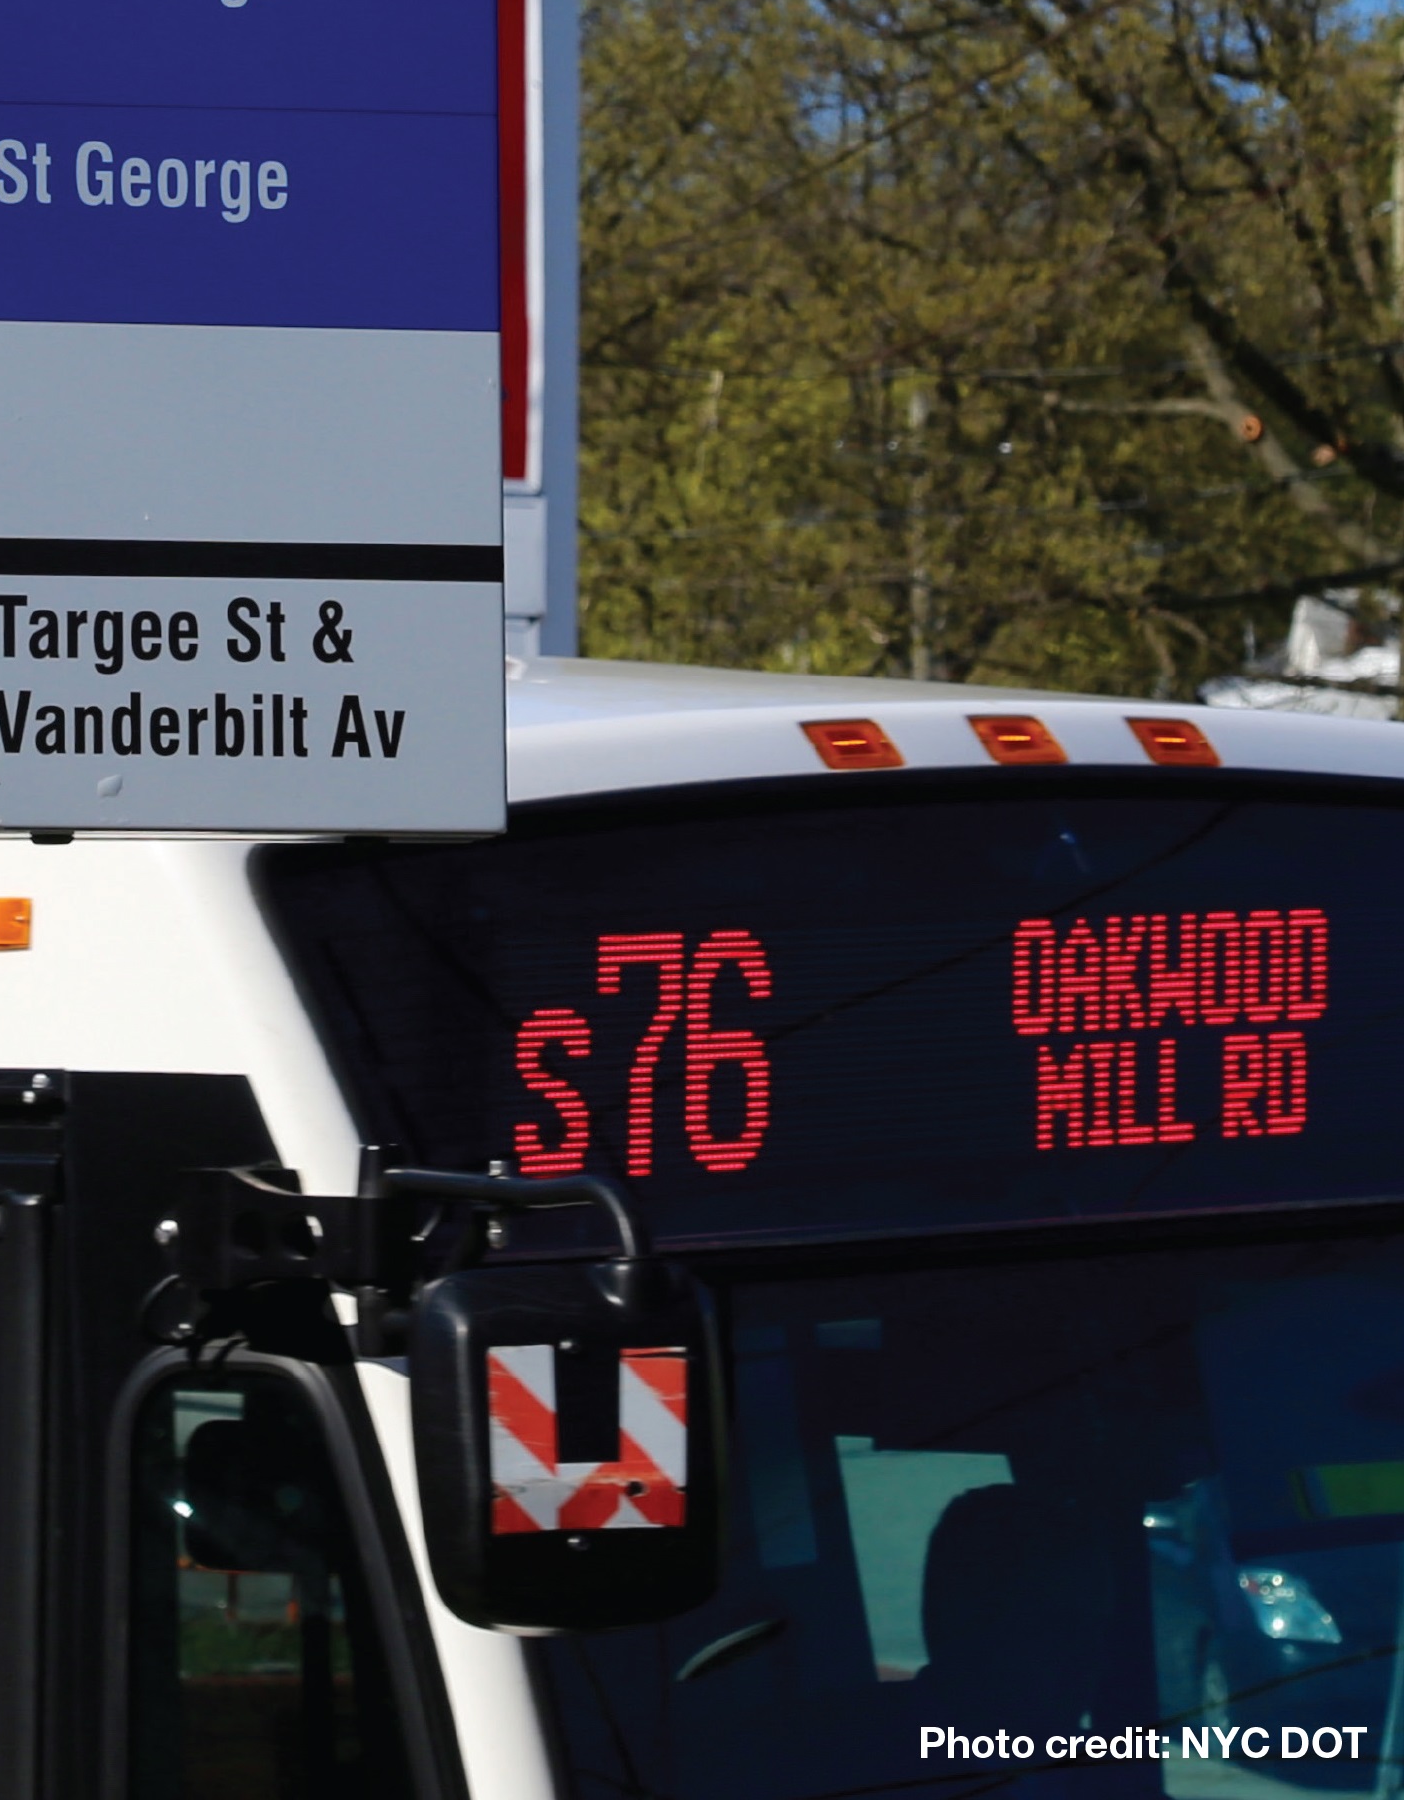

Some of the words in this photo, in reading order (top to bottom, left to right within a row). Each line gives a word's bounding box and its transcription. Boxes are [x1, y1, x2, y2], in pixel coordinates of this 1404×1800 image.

[76, 140, 288, 224] George
[226, 596, 286, 663] St
[312, 600, 355, 664] &
[331, 694, 406, 759] Av
[1011, 908, 1329, 1035] OAKWOOD
[1035, 1038, 1195, 1150] MILL
[1222, 1030, 1308, 1138] RD
